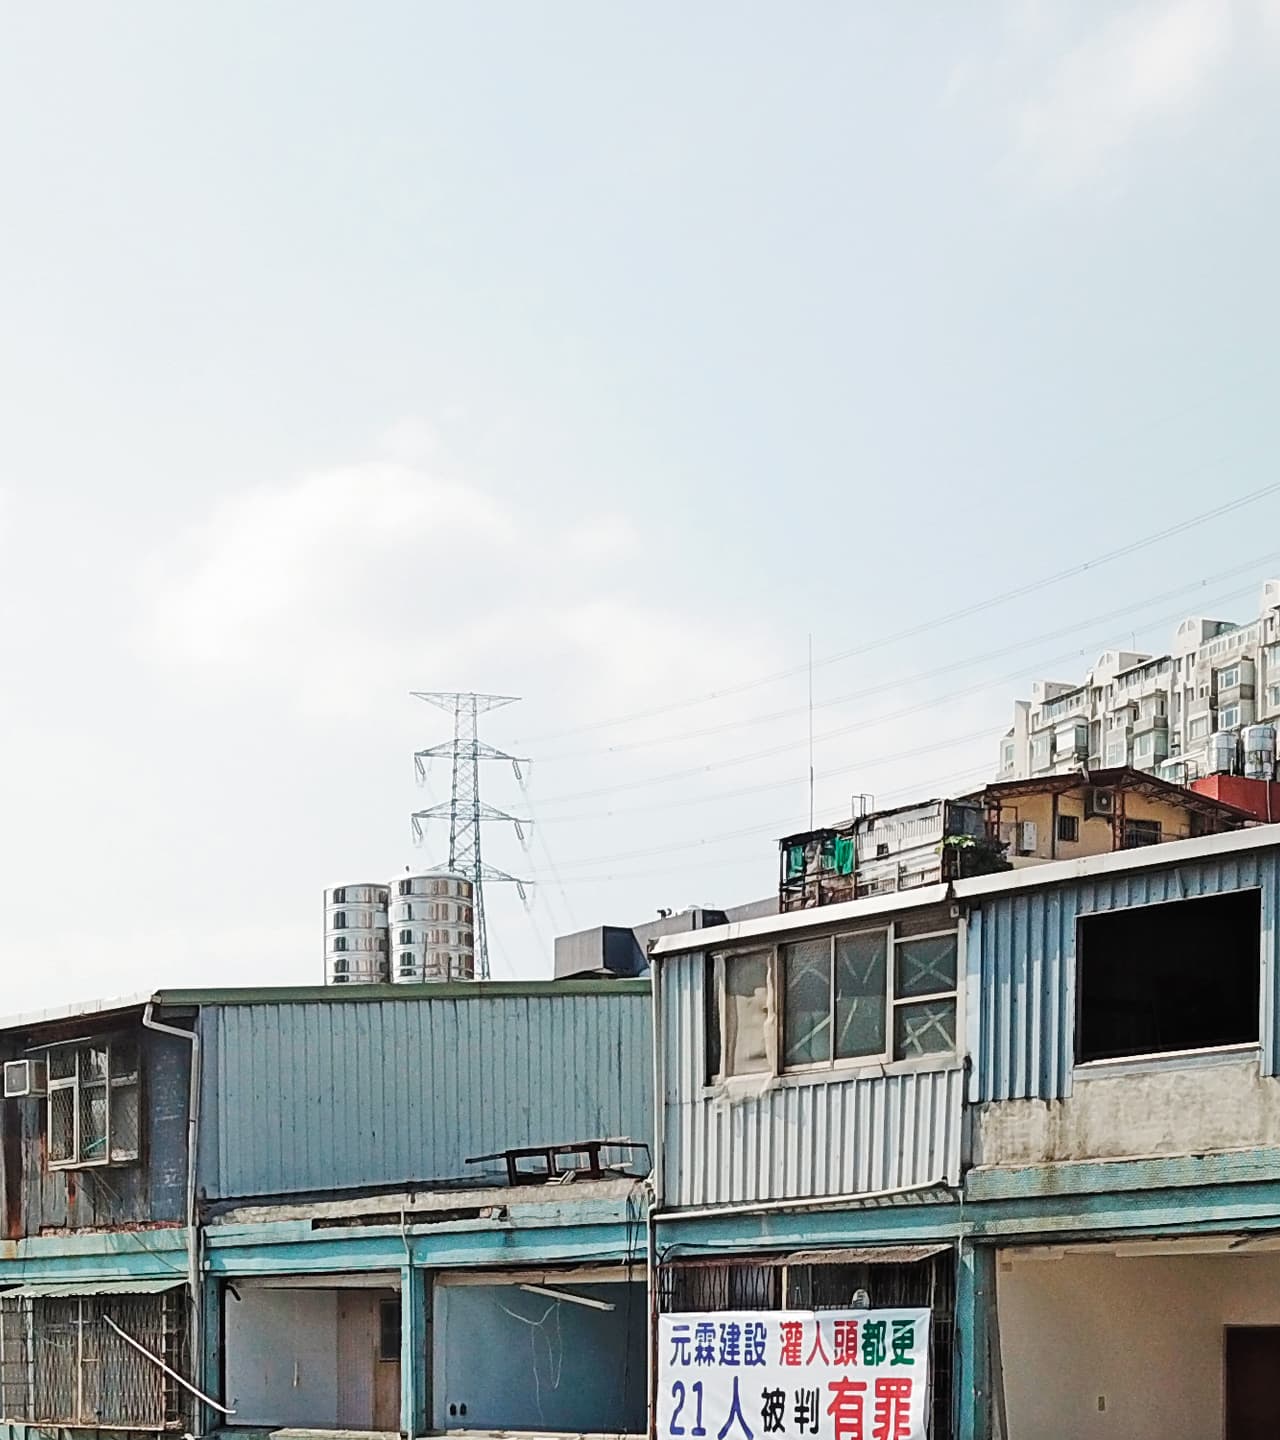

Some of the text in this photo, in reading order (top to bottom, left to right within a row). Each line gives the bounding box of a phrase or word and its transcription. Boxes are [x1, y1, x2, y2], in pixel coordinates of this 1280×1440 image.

[670, 1319, 917, 1368] 元霖建設 灌人頭都更
